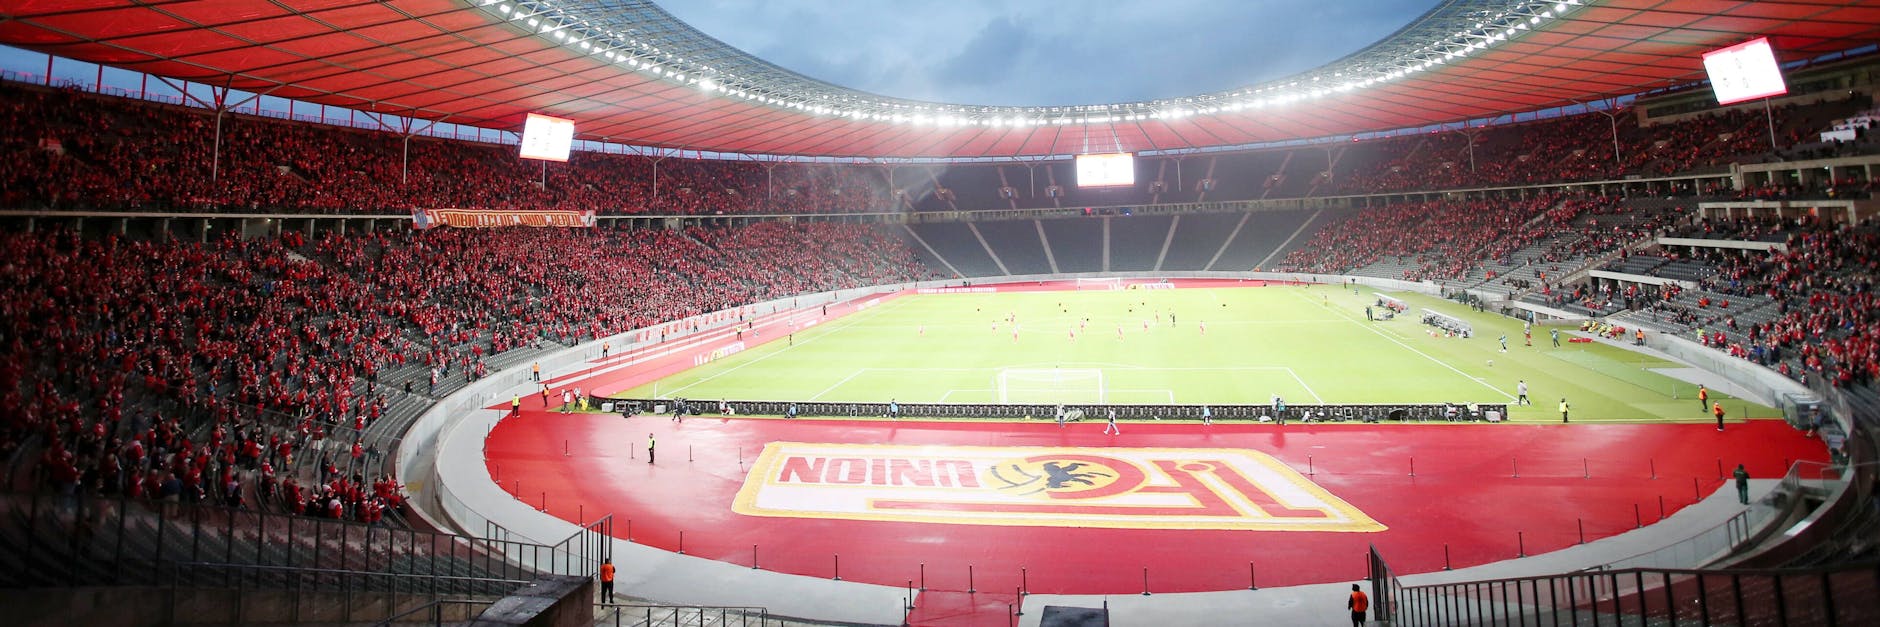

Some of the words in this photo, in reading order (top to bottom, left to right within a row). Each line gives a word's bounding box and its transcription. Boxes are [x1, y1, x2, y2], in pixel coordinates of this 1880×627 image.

[519, 213, 547, 227] UNION
[551, 213, 583, 227] BERLIN
[778, 456, 981, 488] UNION
